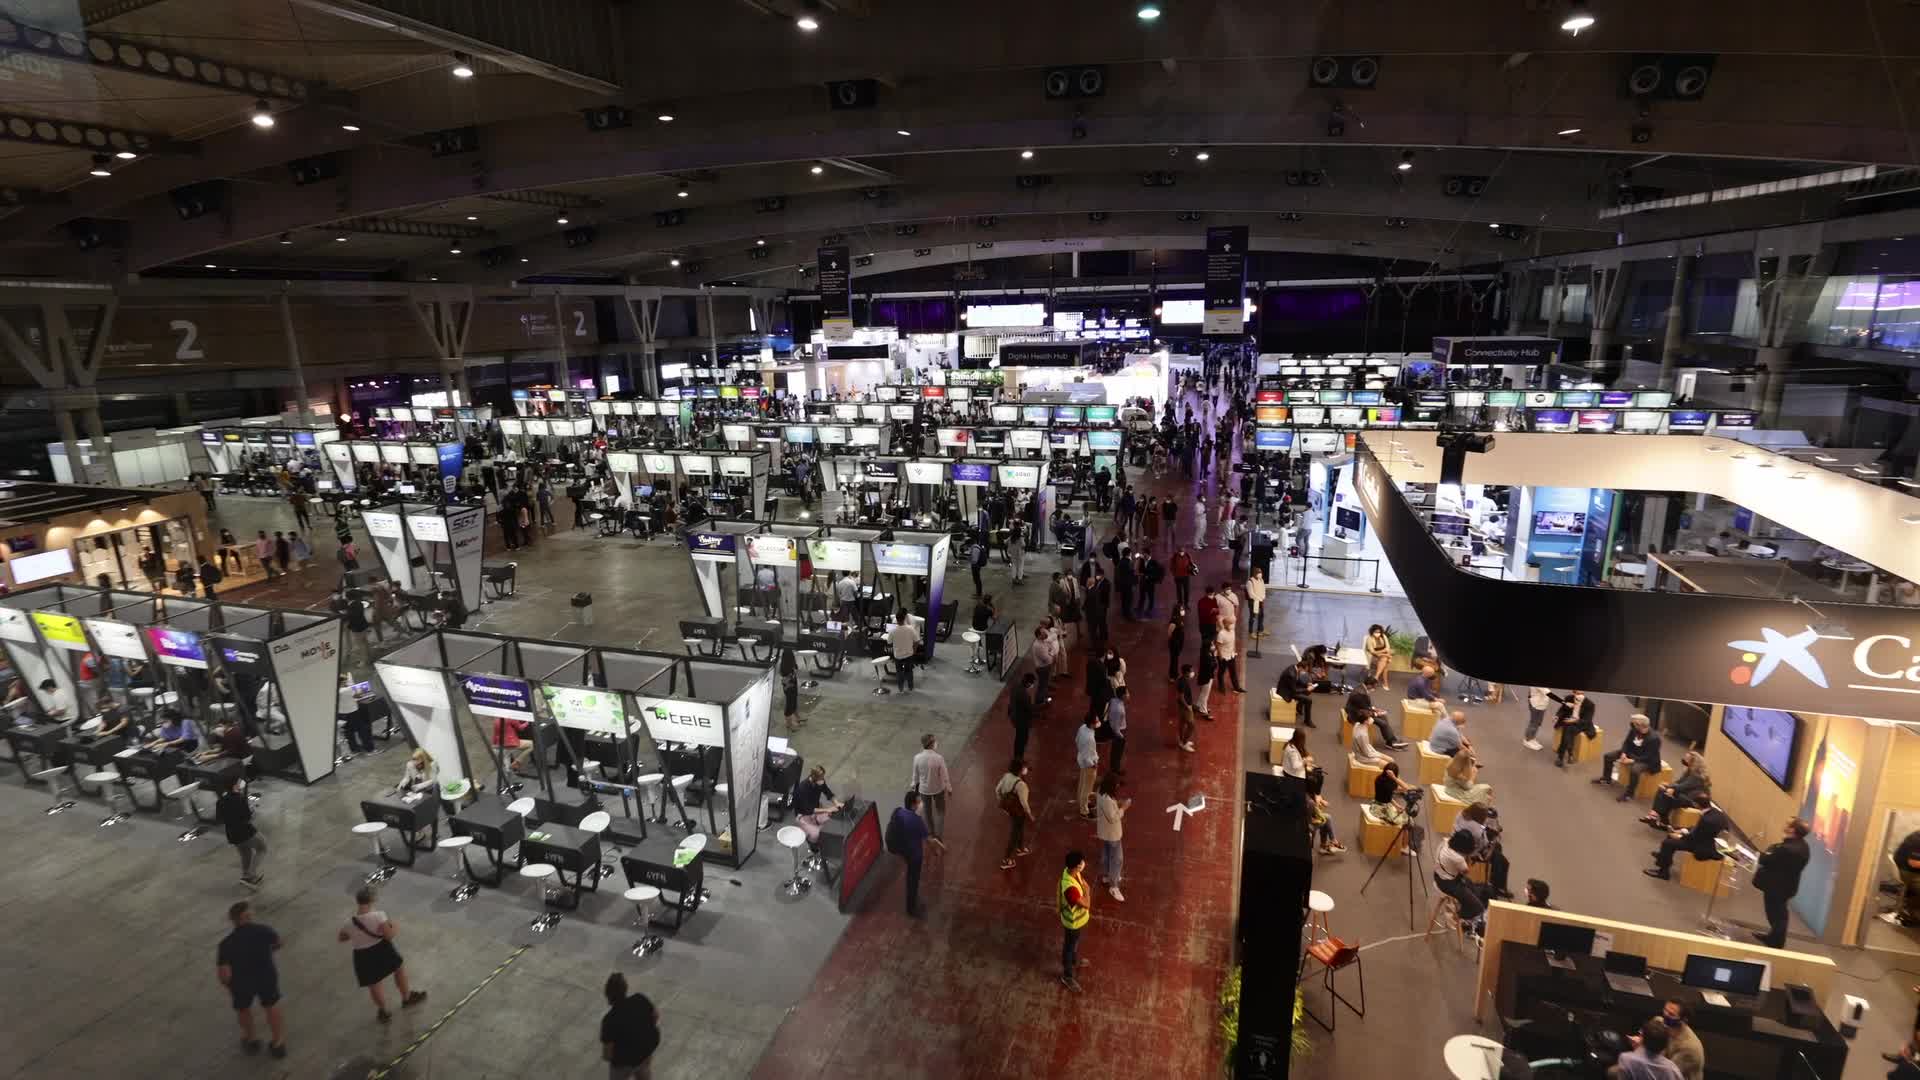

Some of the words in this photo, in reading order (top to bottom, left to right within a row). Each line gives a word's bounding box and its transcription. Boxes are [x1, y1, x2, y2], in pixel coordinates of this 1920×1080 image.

[573, 311, 588, 337] 2
[168, 319, 206, 361] 2
[1053, 352, 1069, 360] Hub
[1464, 348, 1519, 357] Connectivity
[1520, 347, 1541, 357] Hub
[668, 712, 712, 729] tele
